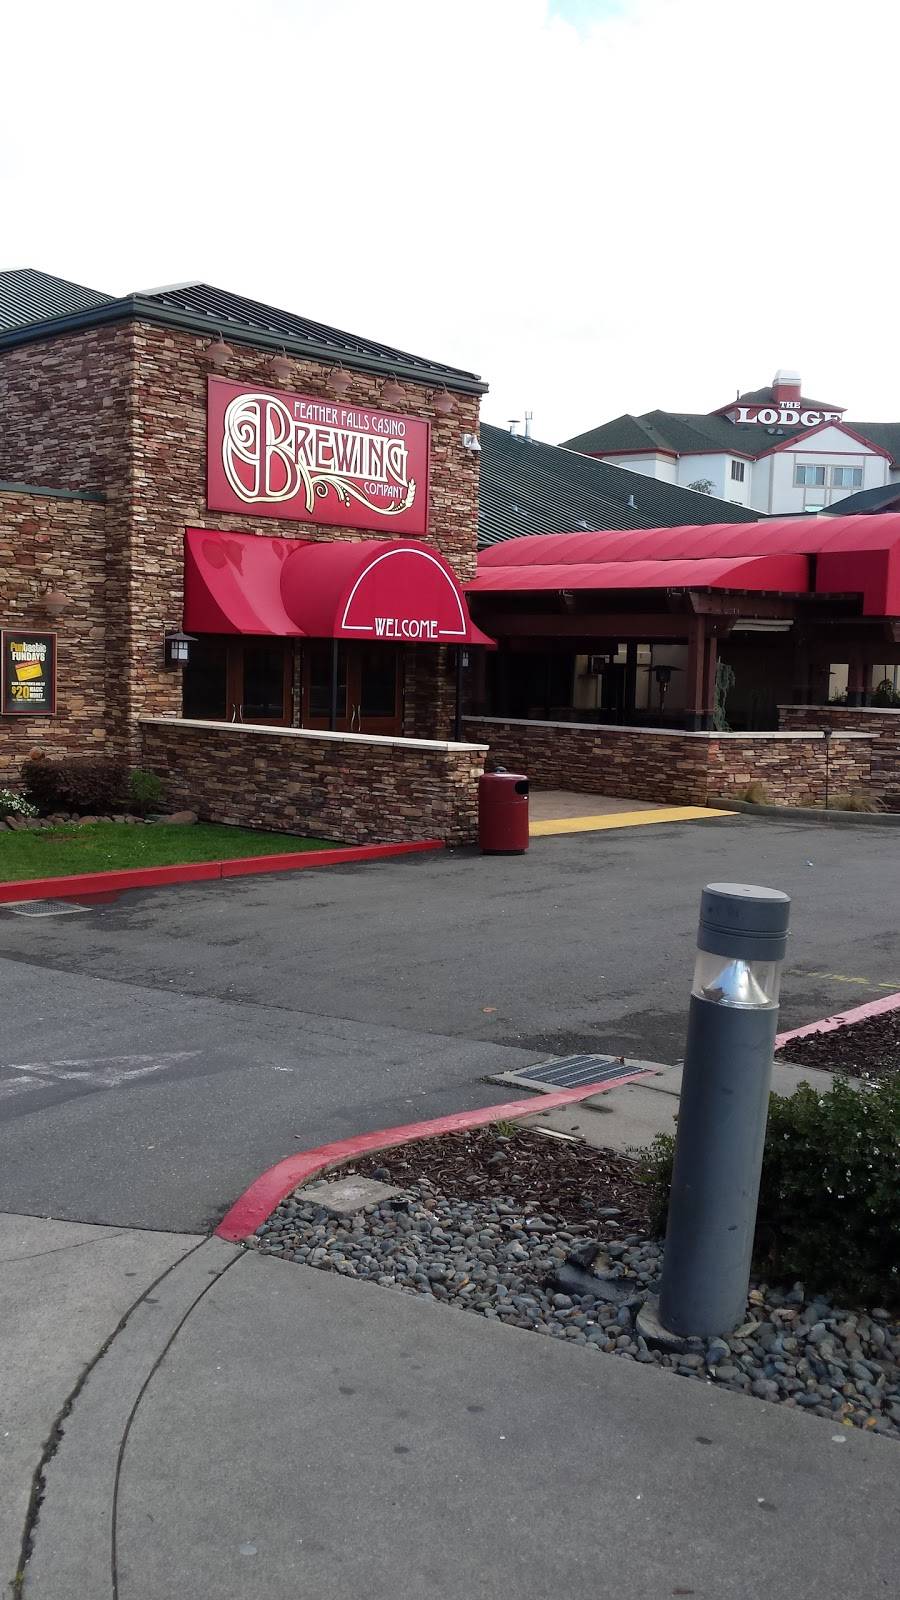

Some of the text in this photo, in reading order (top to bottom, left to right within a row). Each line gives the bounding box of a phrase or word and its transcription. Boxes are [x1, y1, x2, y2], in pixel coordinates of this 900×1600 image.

[780, 401, 801, 409] THE
[294, 401, 406, 437] FEATHER FALLS CASINO
[736, 408, 843, 427] LODGE
[222, 393, 409, 512] BREWING
[363, 481, 404, 499] COMPANY
[374, 617, 438, 638] WELCOME
[12, 652, 45, 661] FUNDAYS
[11, 686, 29, 698] $20
